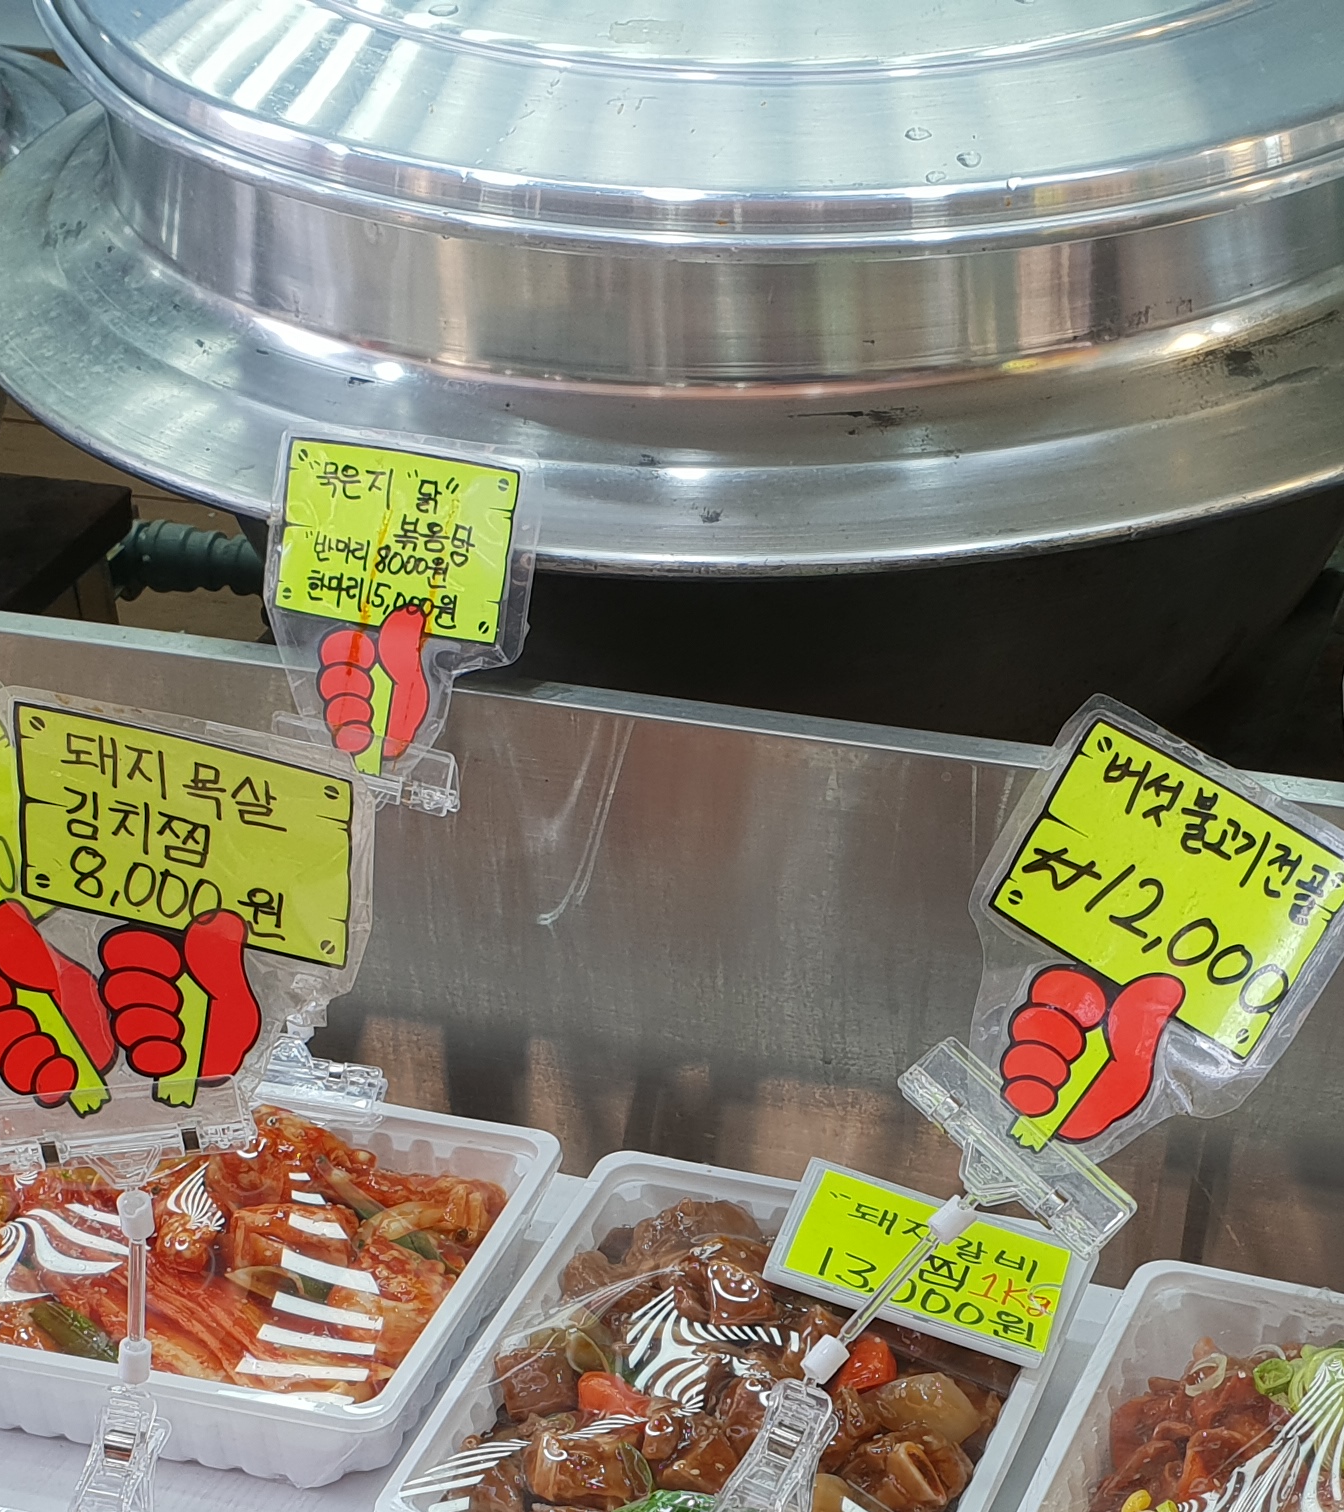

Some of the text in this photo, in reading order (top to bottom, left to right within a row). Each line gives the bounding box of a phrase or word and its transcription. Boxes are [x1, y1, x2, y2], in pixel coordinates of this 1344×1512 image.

[60, 732, 288, 833] 돼지 목살
[63, 786, 211, 868] 김치찜
